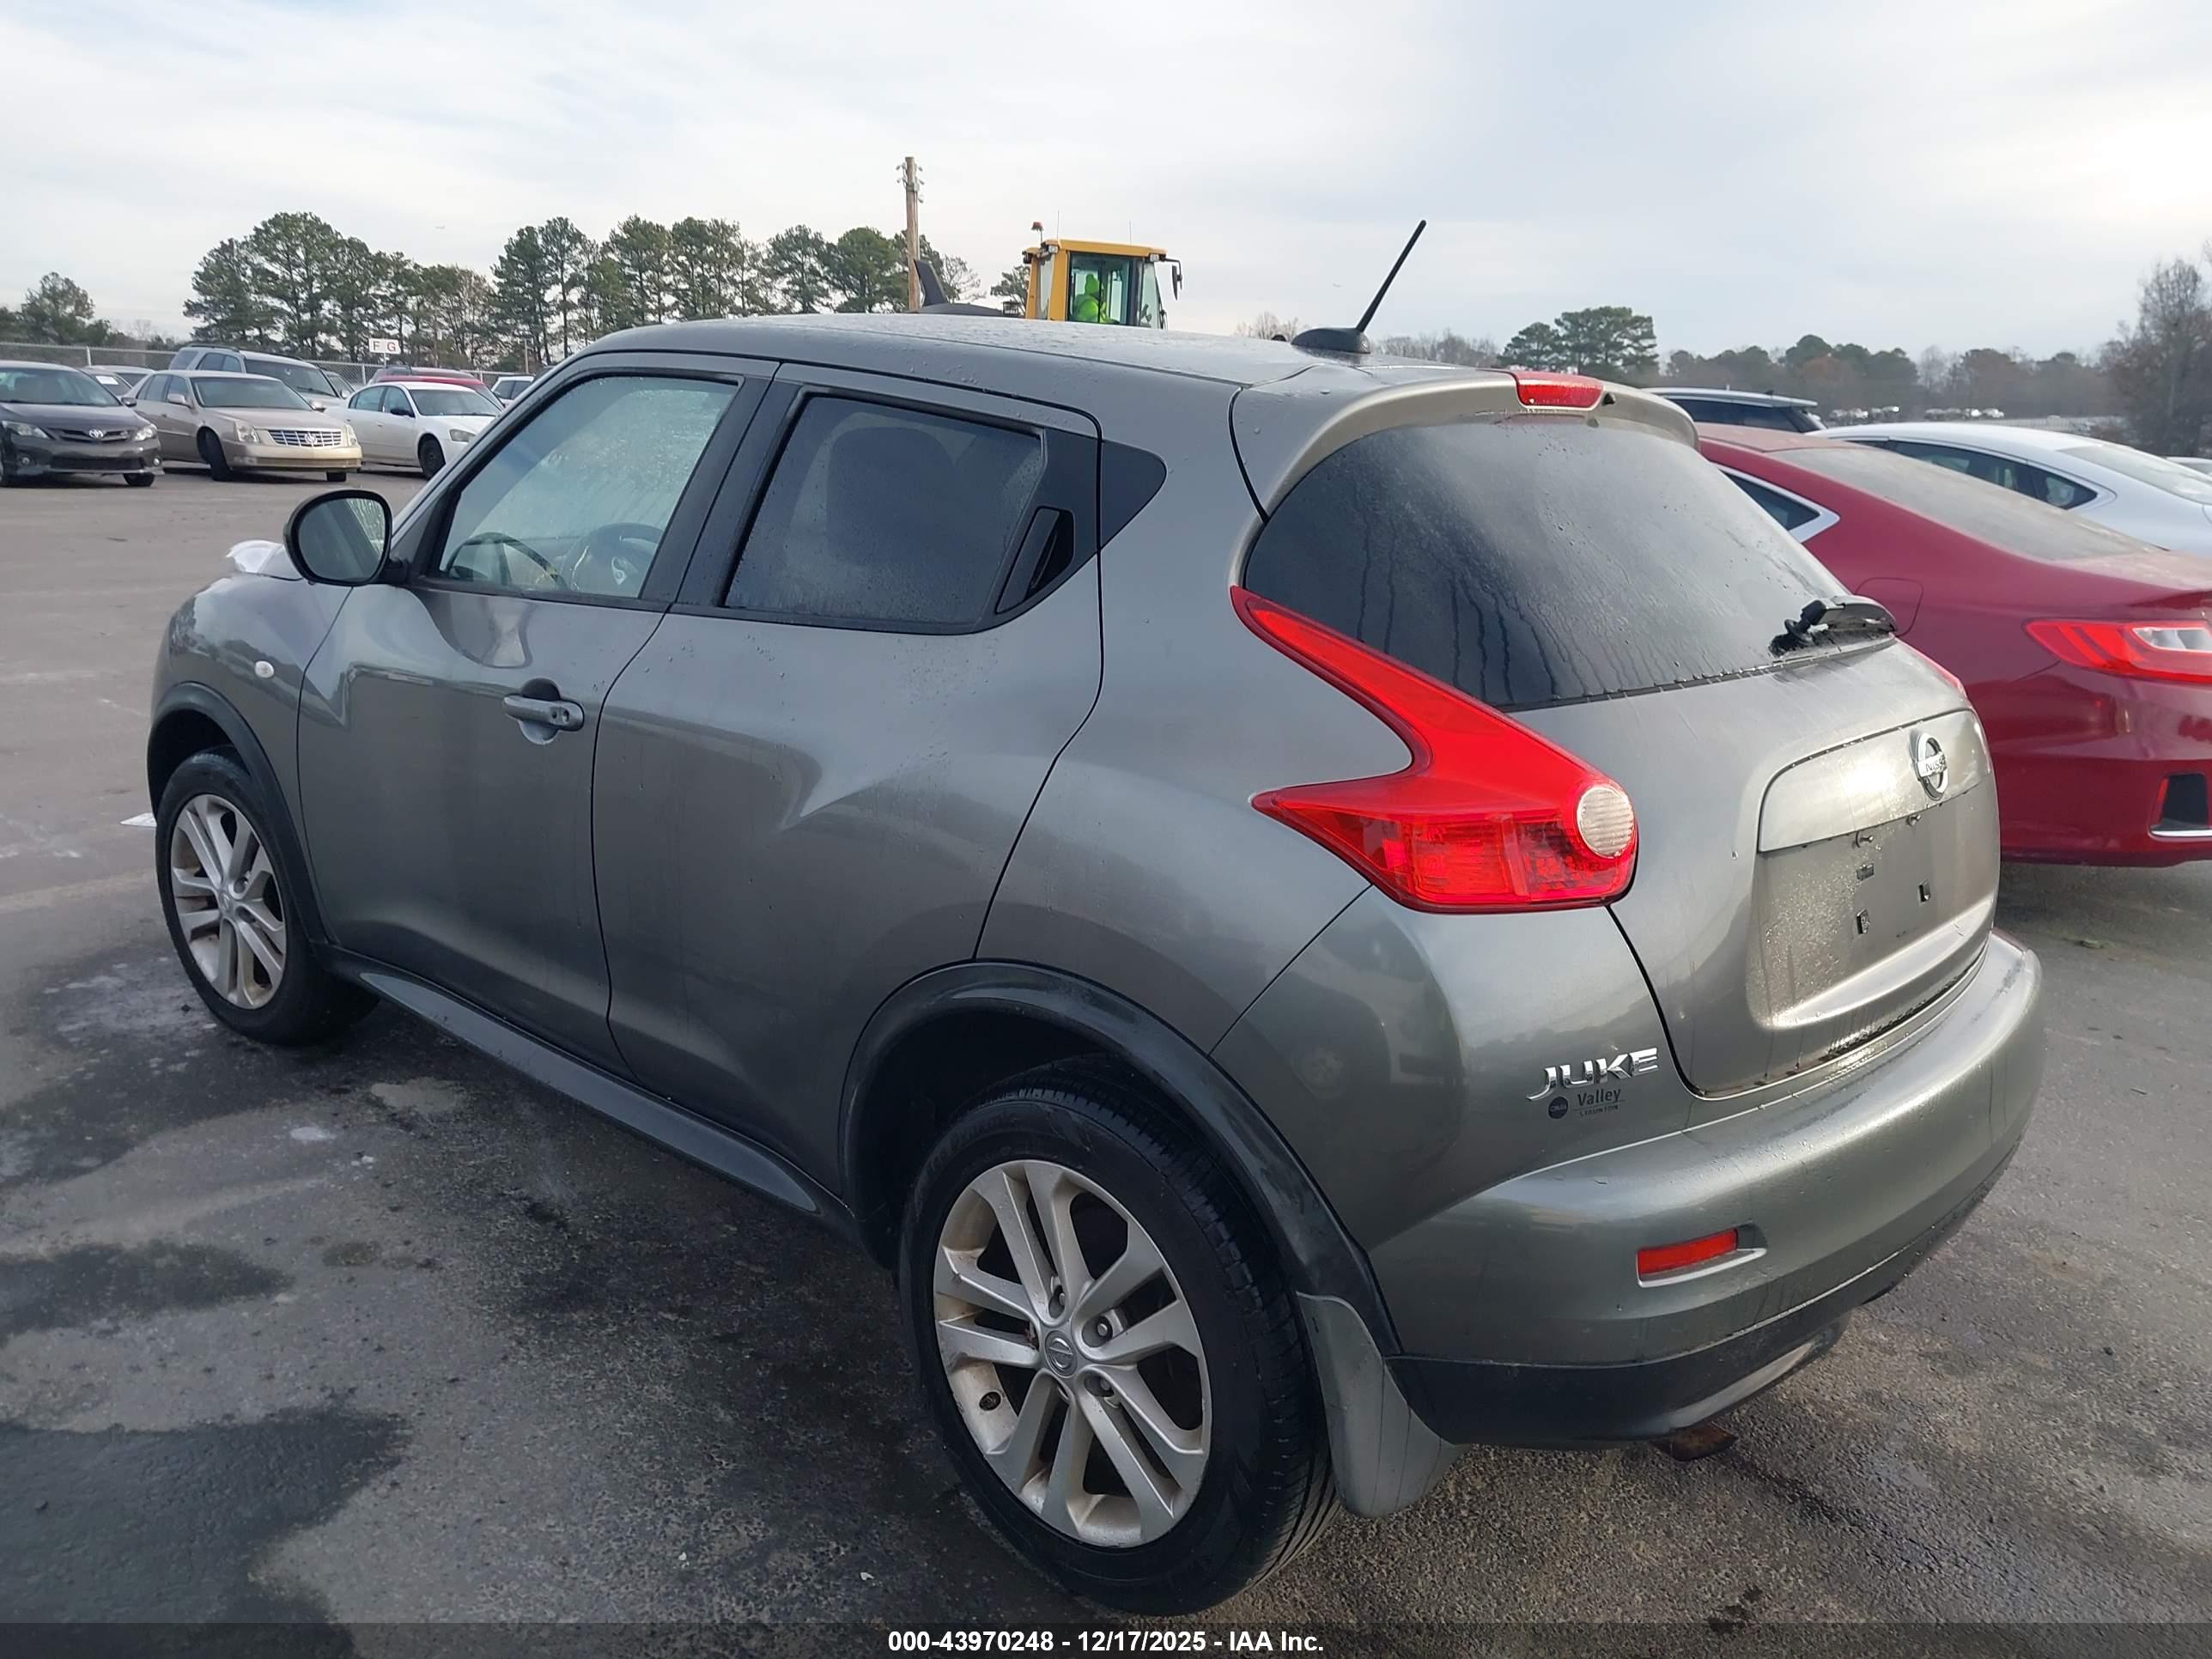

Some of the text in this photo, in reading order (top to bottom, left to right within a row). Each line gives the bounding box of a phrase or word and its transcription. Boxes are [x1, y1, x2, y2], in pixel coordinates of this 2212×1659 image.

[373, 341, 397, 351] F G
[1526, 1047, 1659, 1101] JUKE
[1577, 1088, 1622, 1107] Valley
